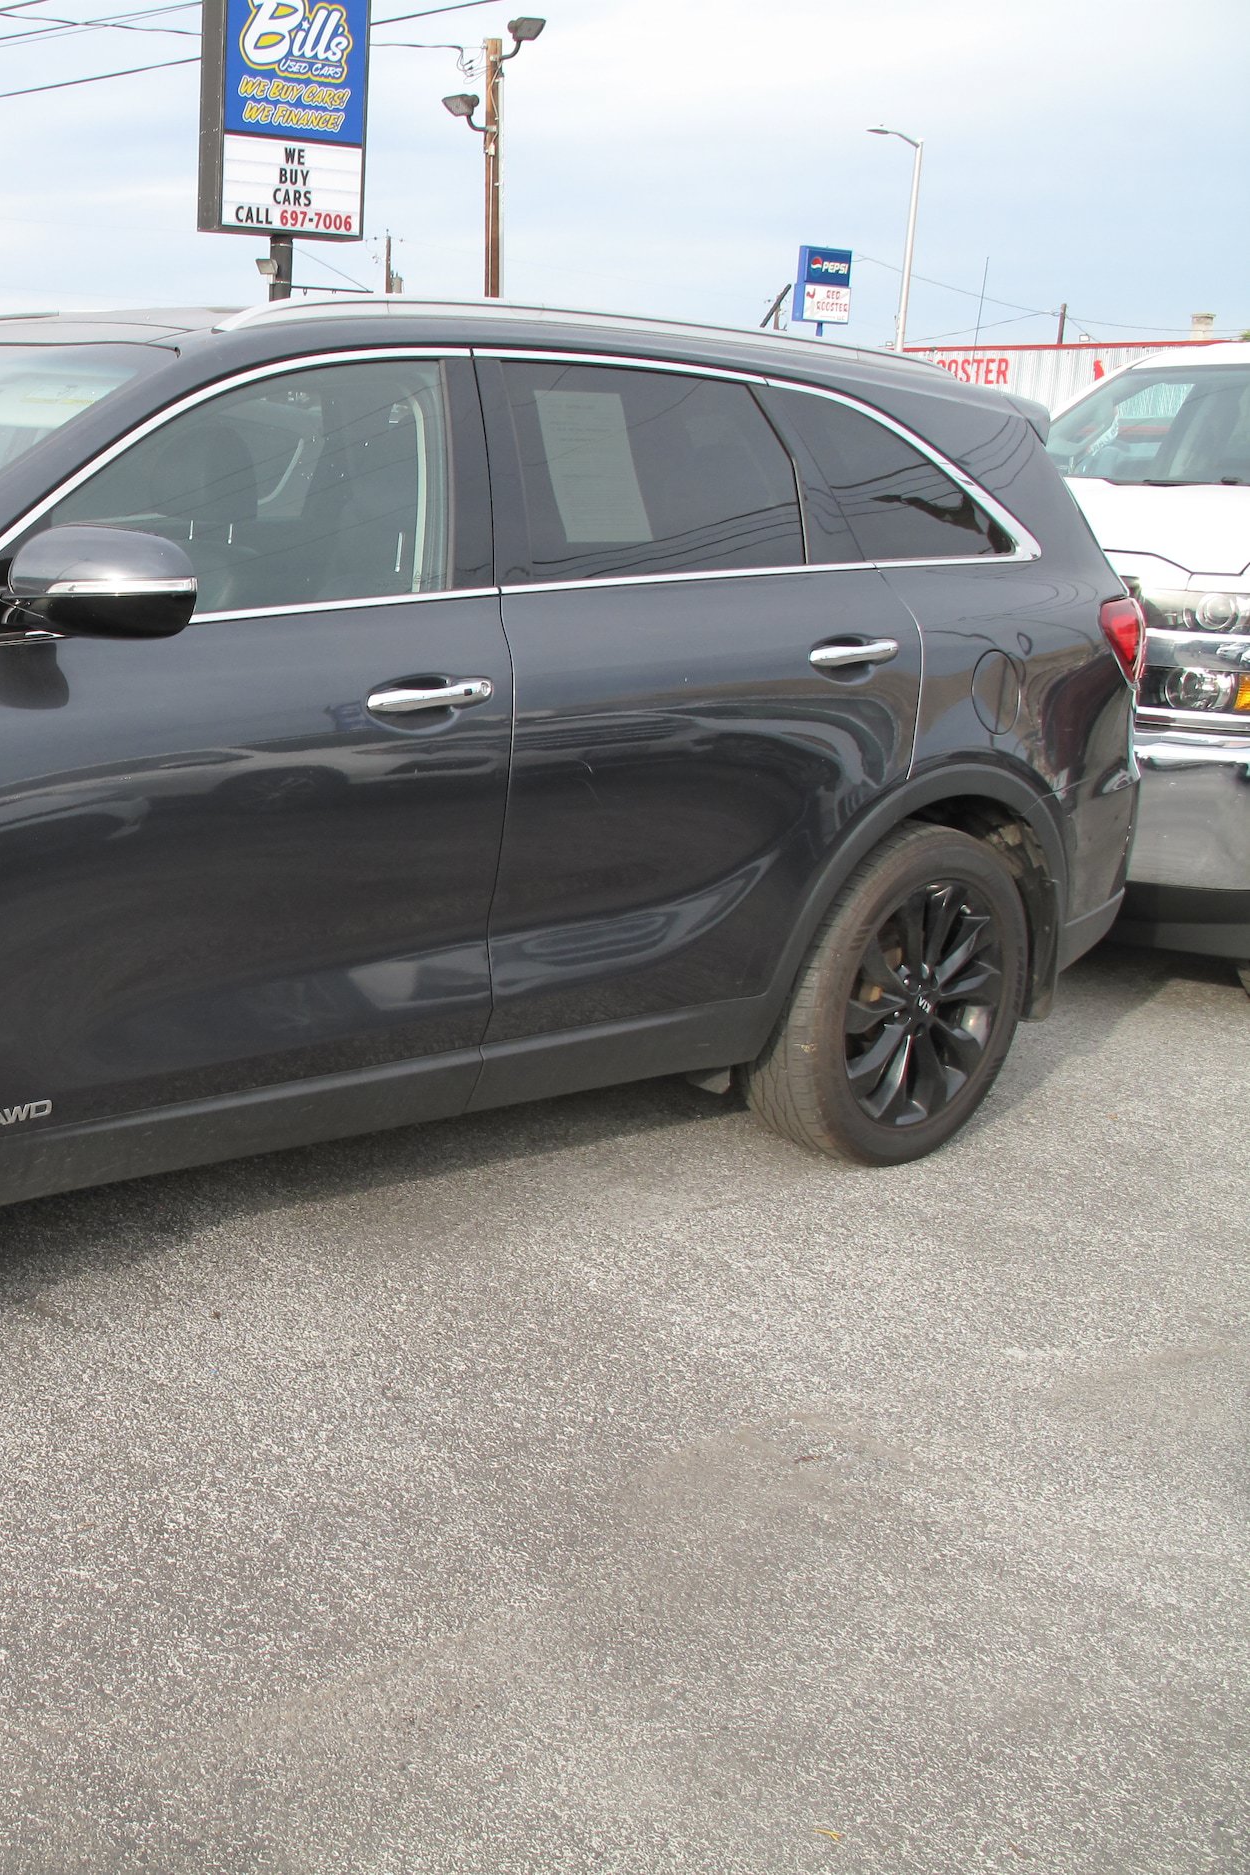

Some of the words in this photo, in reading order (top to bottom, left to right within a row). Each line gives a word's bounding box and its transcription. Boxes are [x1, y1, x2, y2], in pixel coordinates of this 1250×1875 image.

[280, 60, 310, 74] USED
[312, 64, 343, 78] CARS
[239, 77, 269, 97] WE
[269, 80, 302, 100] BUY
[303, 86, 349, 107] CARS!
[244, 103, 272, 121] WE
[273, 106, 344, 131] FINANCE!
[285, 147, 305, 165] WE
[279, 167, 310, 186] BUY
[273, 188, 311, 207] CARS
[235, 206, 273, 225] CALL
[280, 210, 352, 232] 697-7006
[822, 261, 848, 274] PEPSI
[826, 289, 841, 300] RED
[816, 301, 848, 312] ROOSTER
[928, 358, 1009, 384] OSTER
